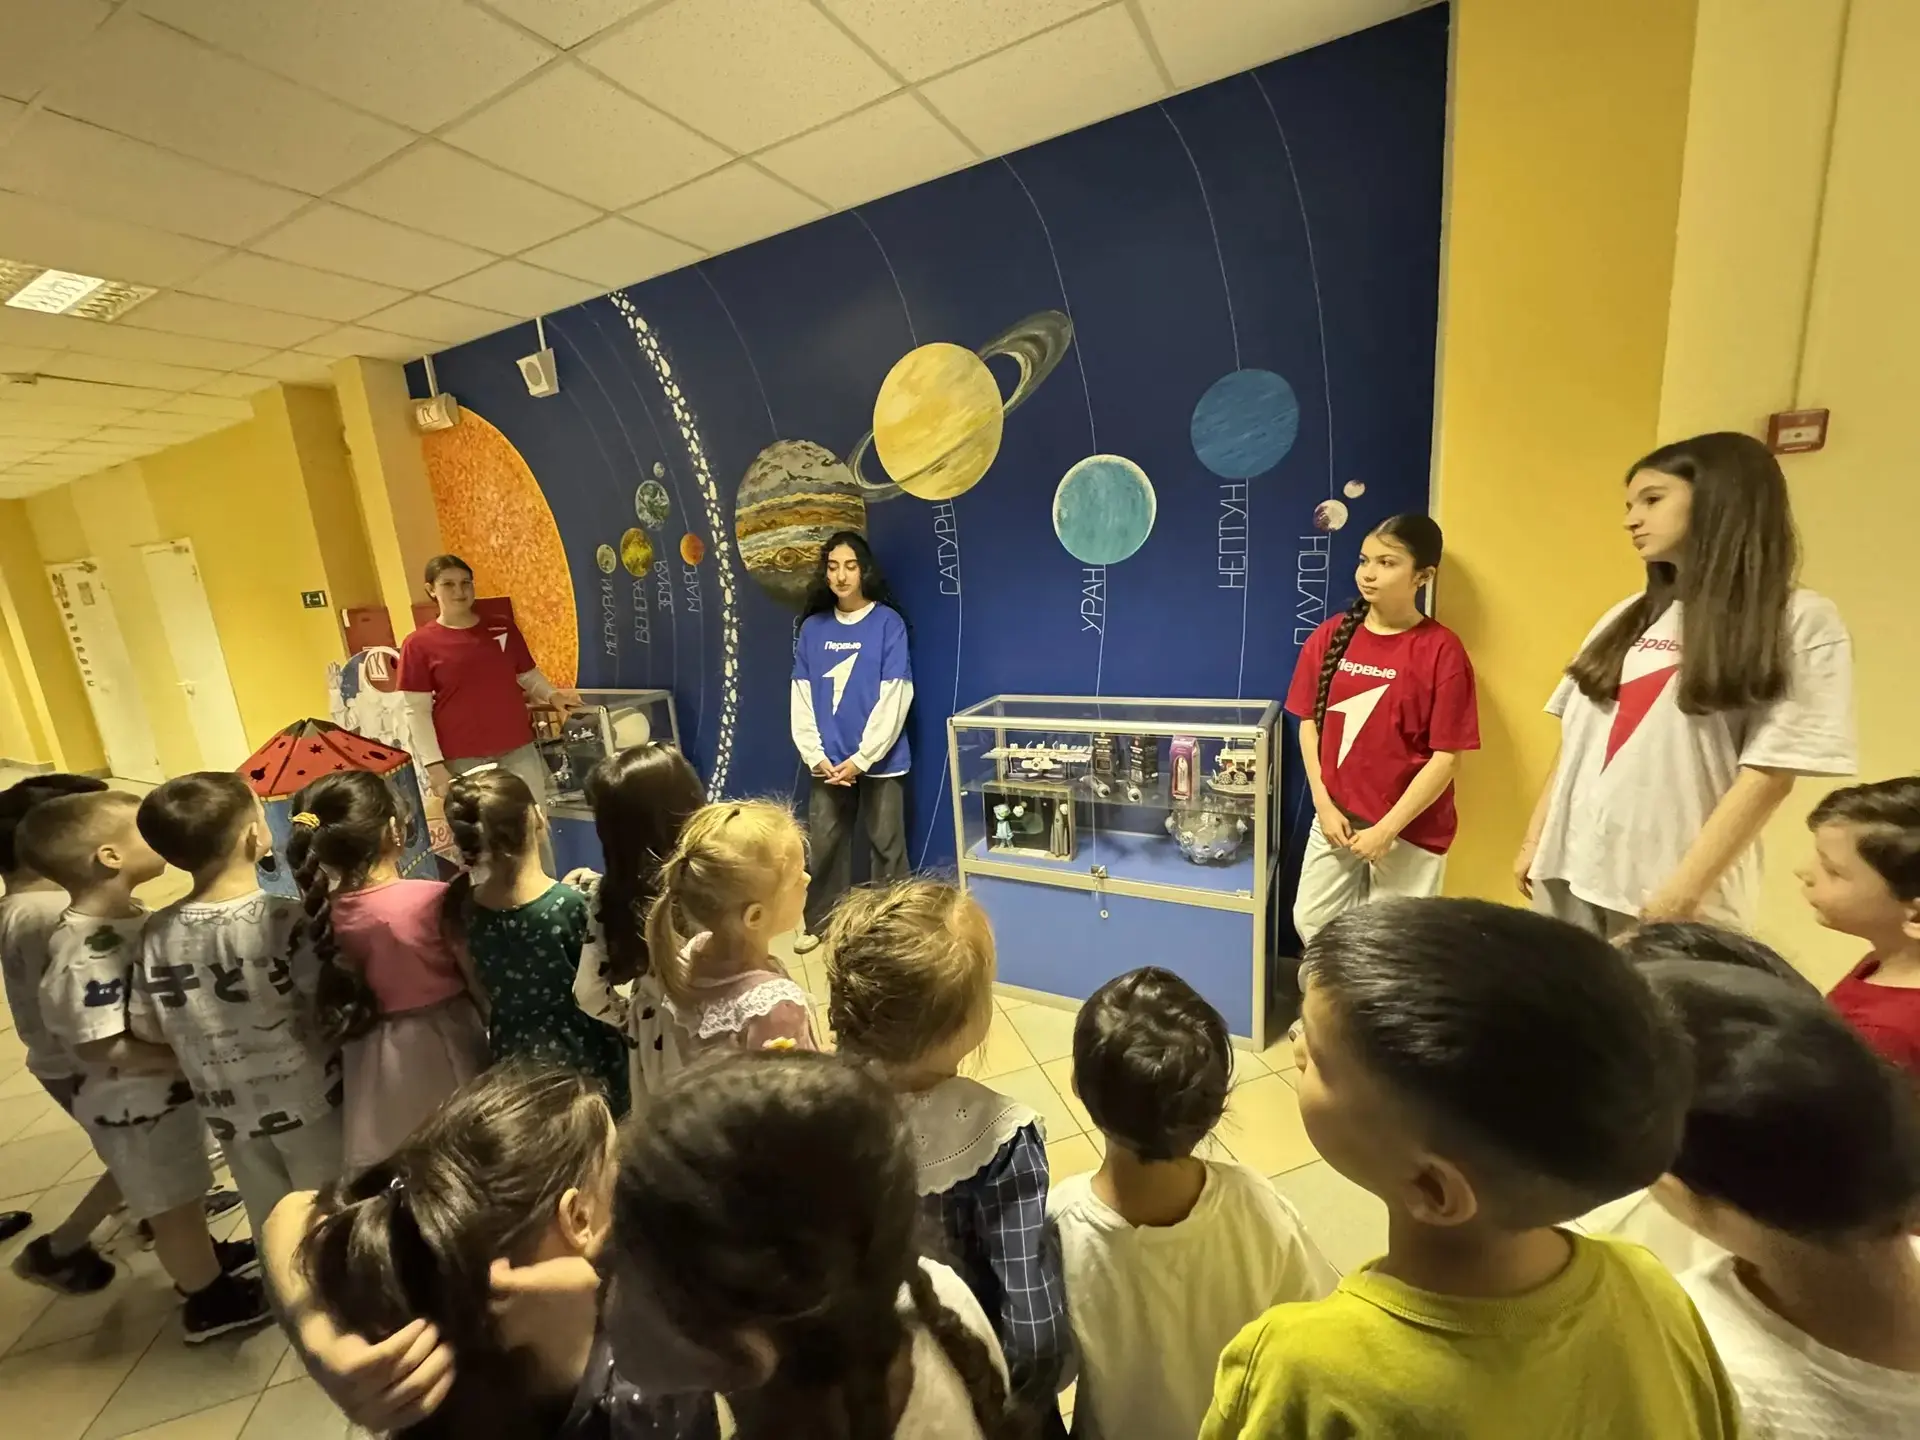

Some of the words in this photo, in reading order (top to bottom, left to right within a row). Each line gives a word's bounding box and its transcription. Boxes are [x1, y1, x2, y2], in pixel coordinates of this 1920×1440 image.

[931, 503, 959, 595] САТУРН
[1217, 484, 1246, 589] НЕПТУН
[632, 579, 650, 644] ВЕНЕРА
[653, 560, 674, 614] ЗЕМЛЯ
[682, 563, 701, 612] МАРС
[1080, 568, 1105, 635] УРАН
[1293, 536, 1328, 645] ПЛУТОН
[824, 640, 862, 653] Первые
